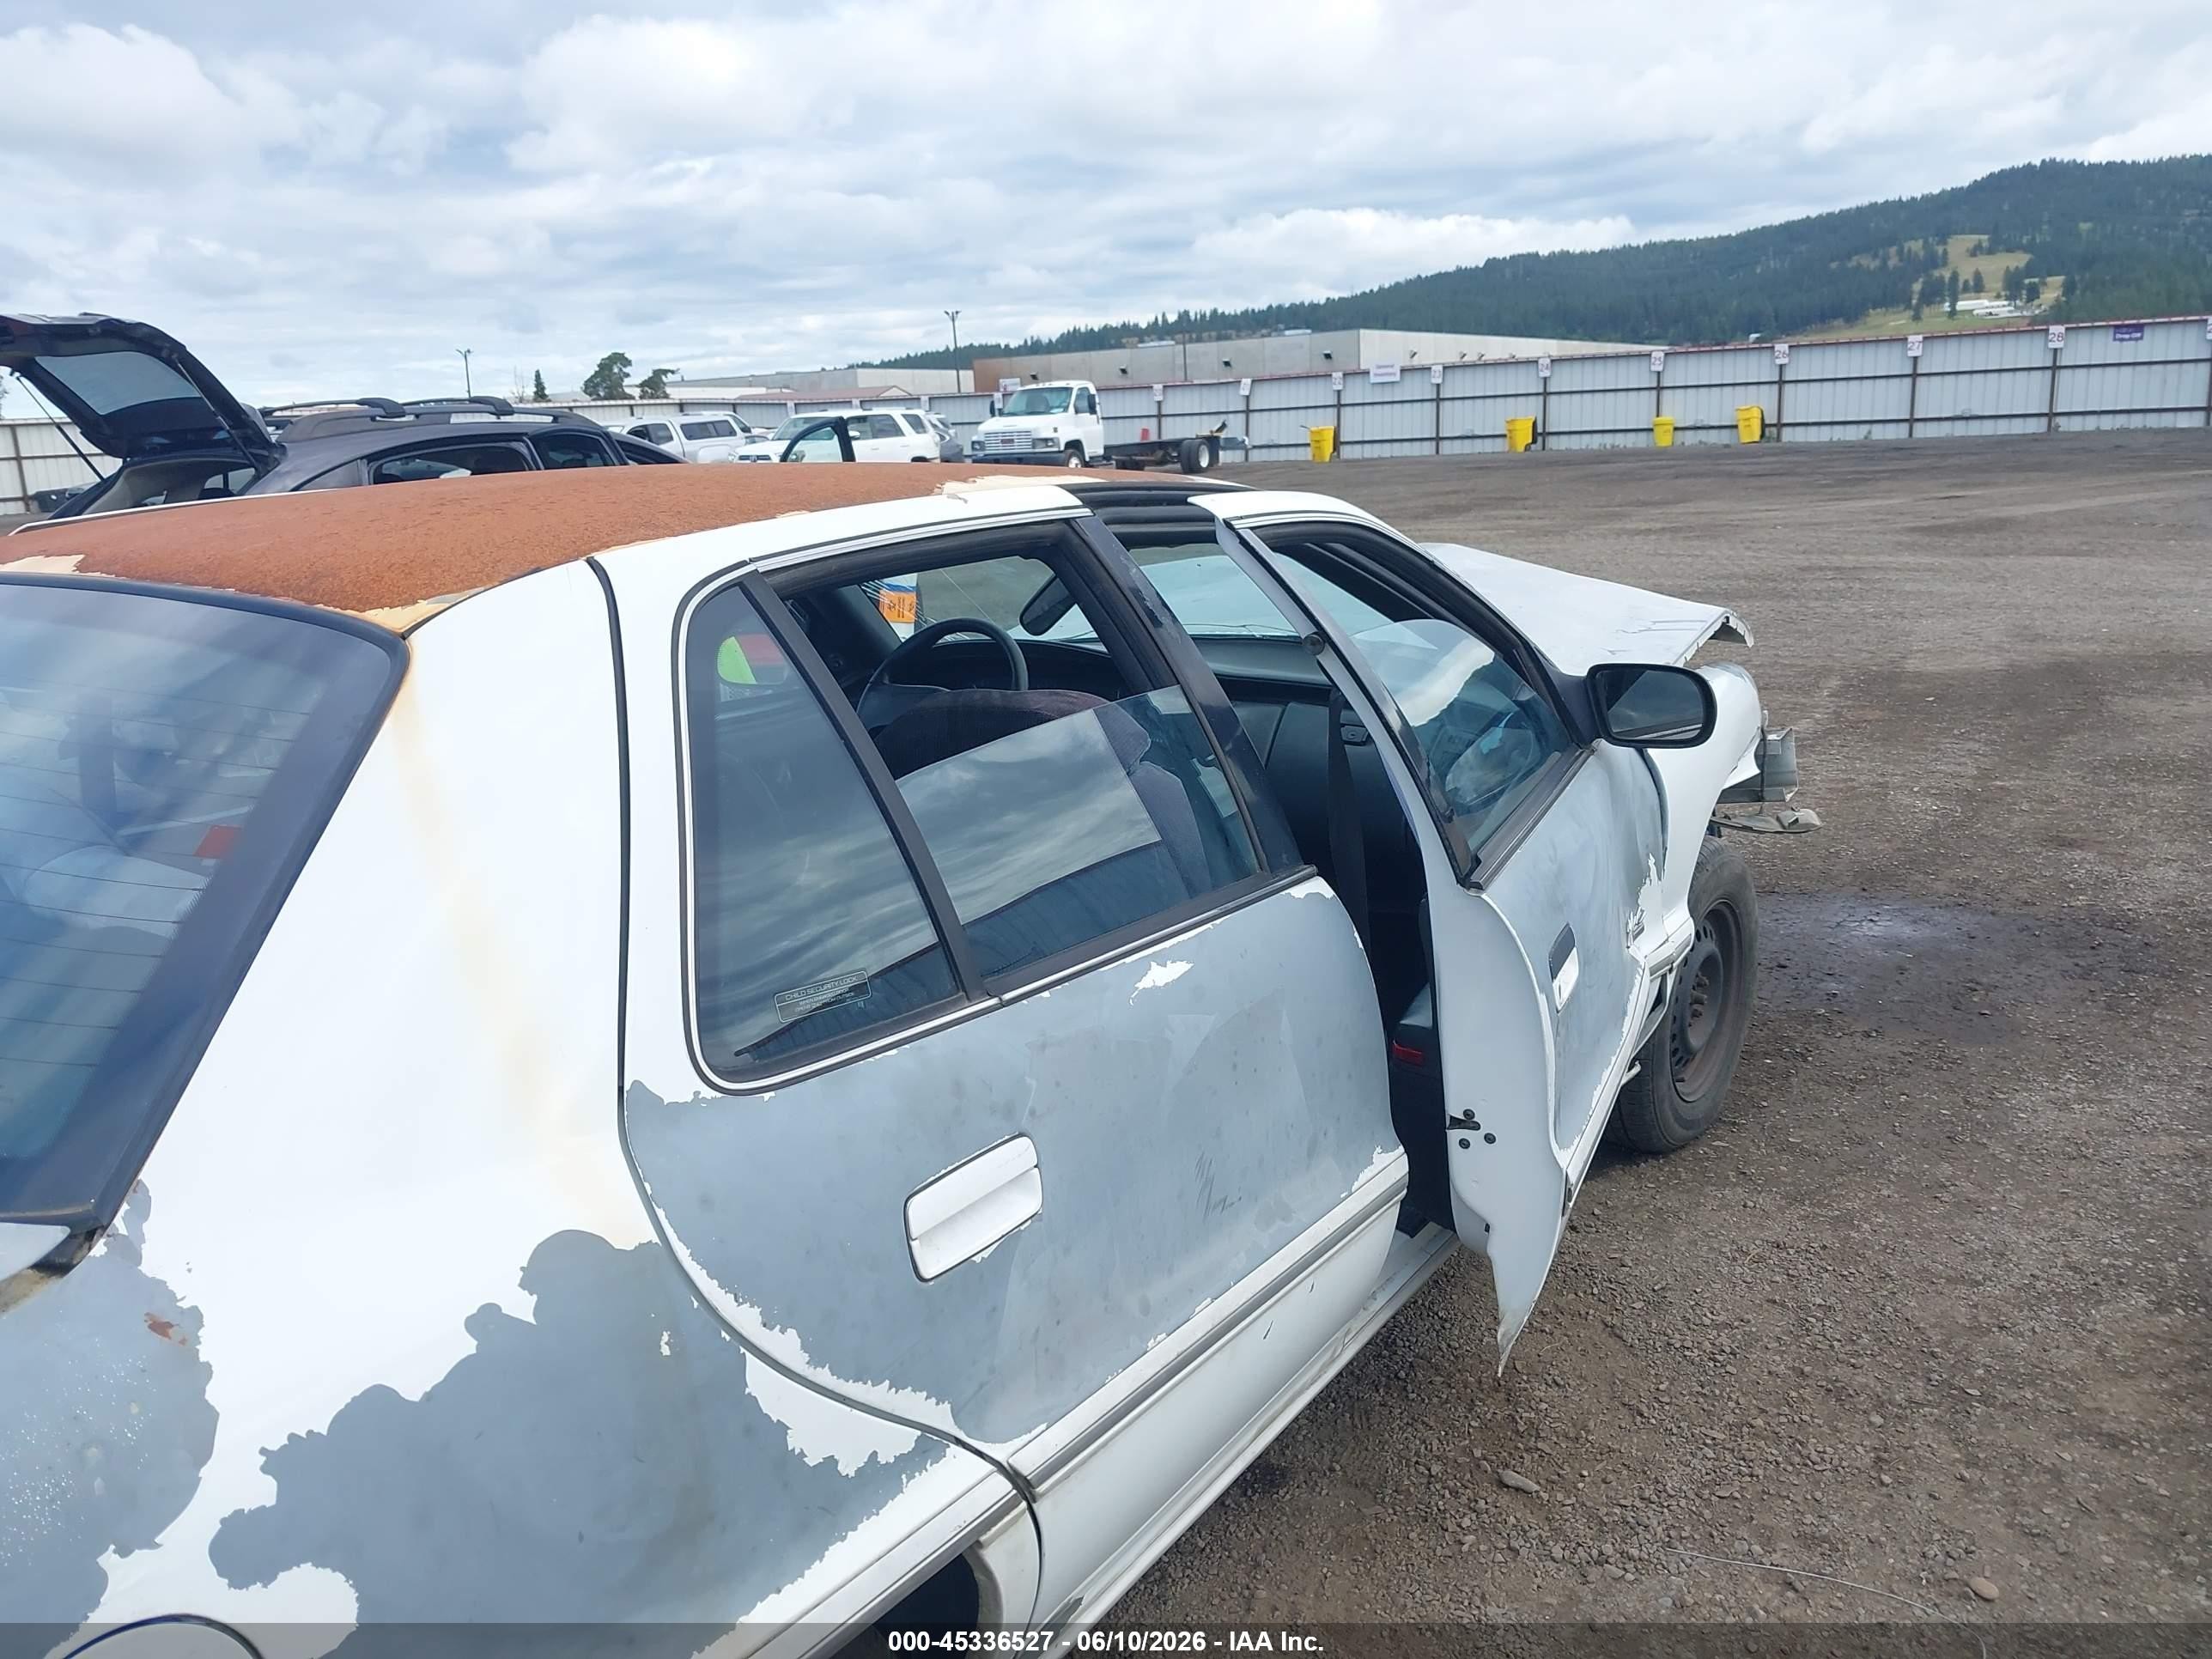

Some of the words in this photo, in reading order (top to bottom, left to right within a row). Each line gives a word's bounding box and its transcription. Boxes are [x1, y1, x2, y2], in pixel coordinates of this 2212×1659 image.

[2049, 331, 2064, 343] 28
[1908, 340, 1923, 351] 27
[1774, 349, 1789, 359] 26
[1651, 356, 1663, 366] 25
[1539, 363, 1549, 373] 24
[785, 991, 806, 1000] CHILD
[807, 981, 839, 994] SECURITY
[839, 975, 857, 986] LOCK
